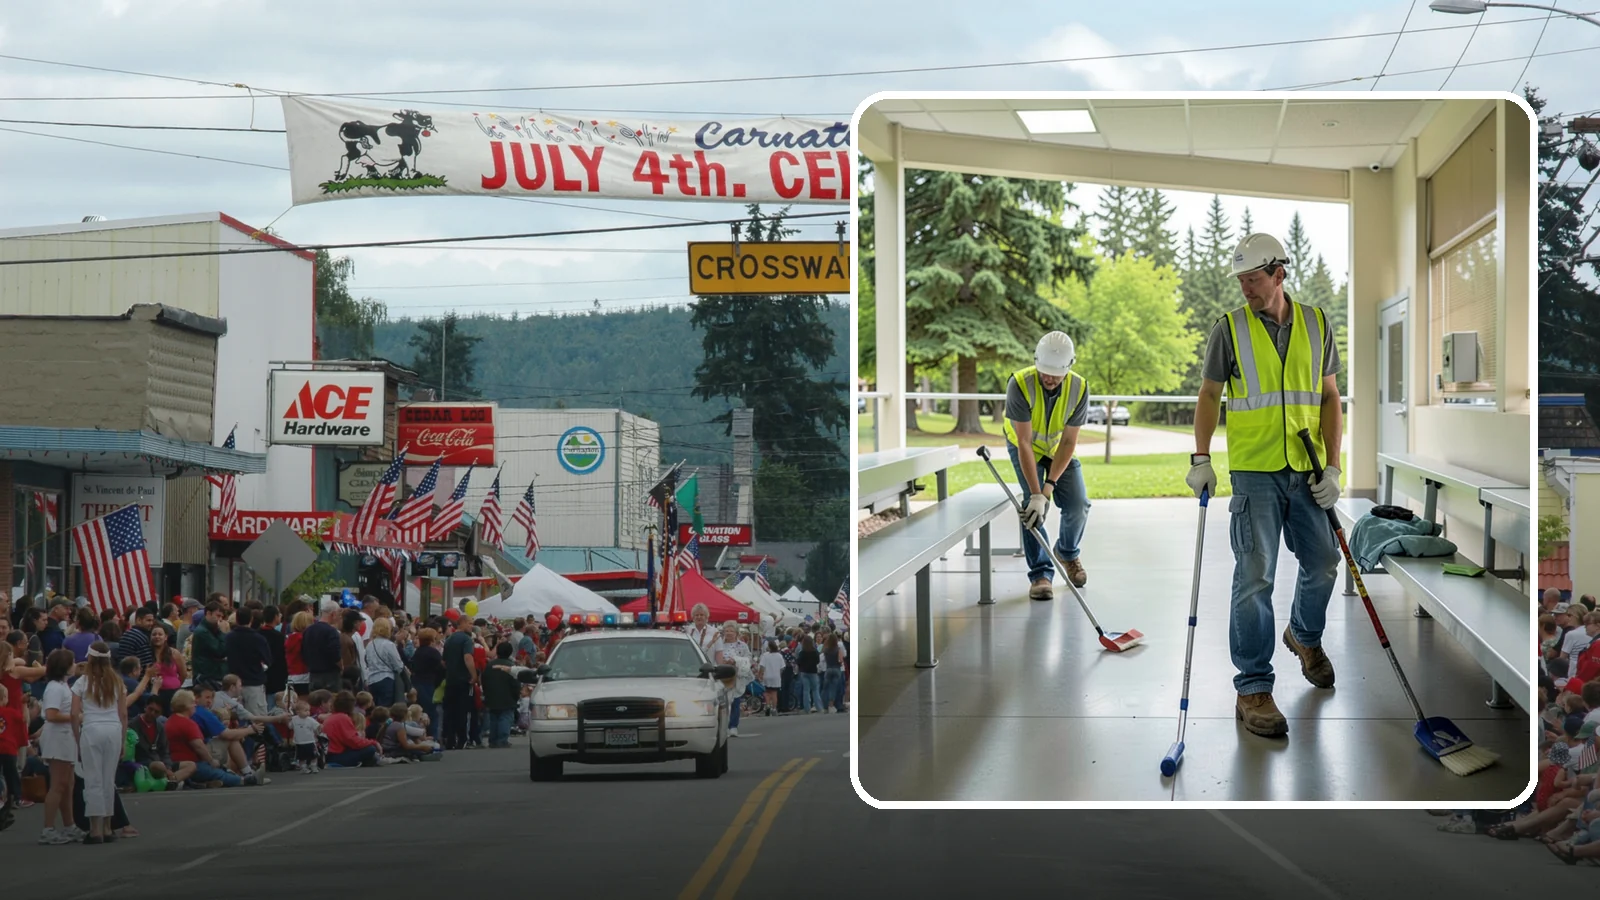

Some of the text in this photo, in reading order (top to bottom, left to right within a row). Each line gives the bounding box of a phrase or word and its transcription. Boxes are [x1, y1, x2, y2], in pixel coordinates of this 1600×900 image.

[481, 140, 605, 192] JULY
[632, 150, 746, 198] 4th.
[697, 254, 850, 280] CROSSWA
[283, 380, 373, 420] ACE
[284, 421, 370, 436] Hardware
[416, 428, 477, 447] Coca-Cola
[96, 485, 124, 495] Vincent
[126, 486, 136, 495] de
[137, 486, 155, 495] Paul
[212, 516, 331, 535] HARDARE
[688, 526, 742, 535] CRNATION
[699, 535, 730, 543] GLASS
